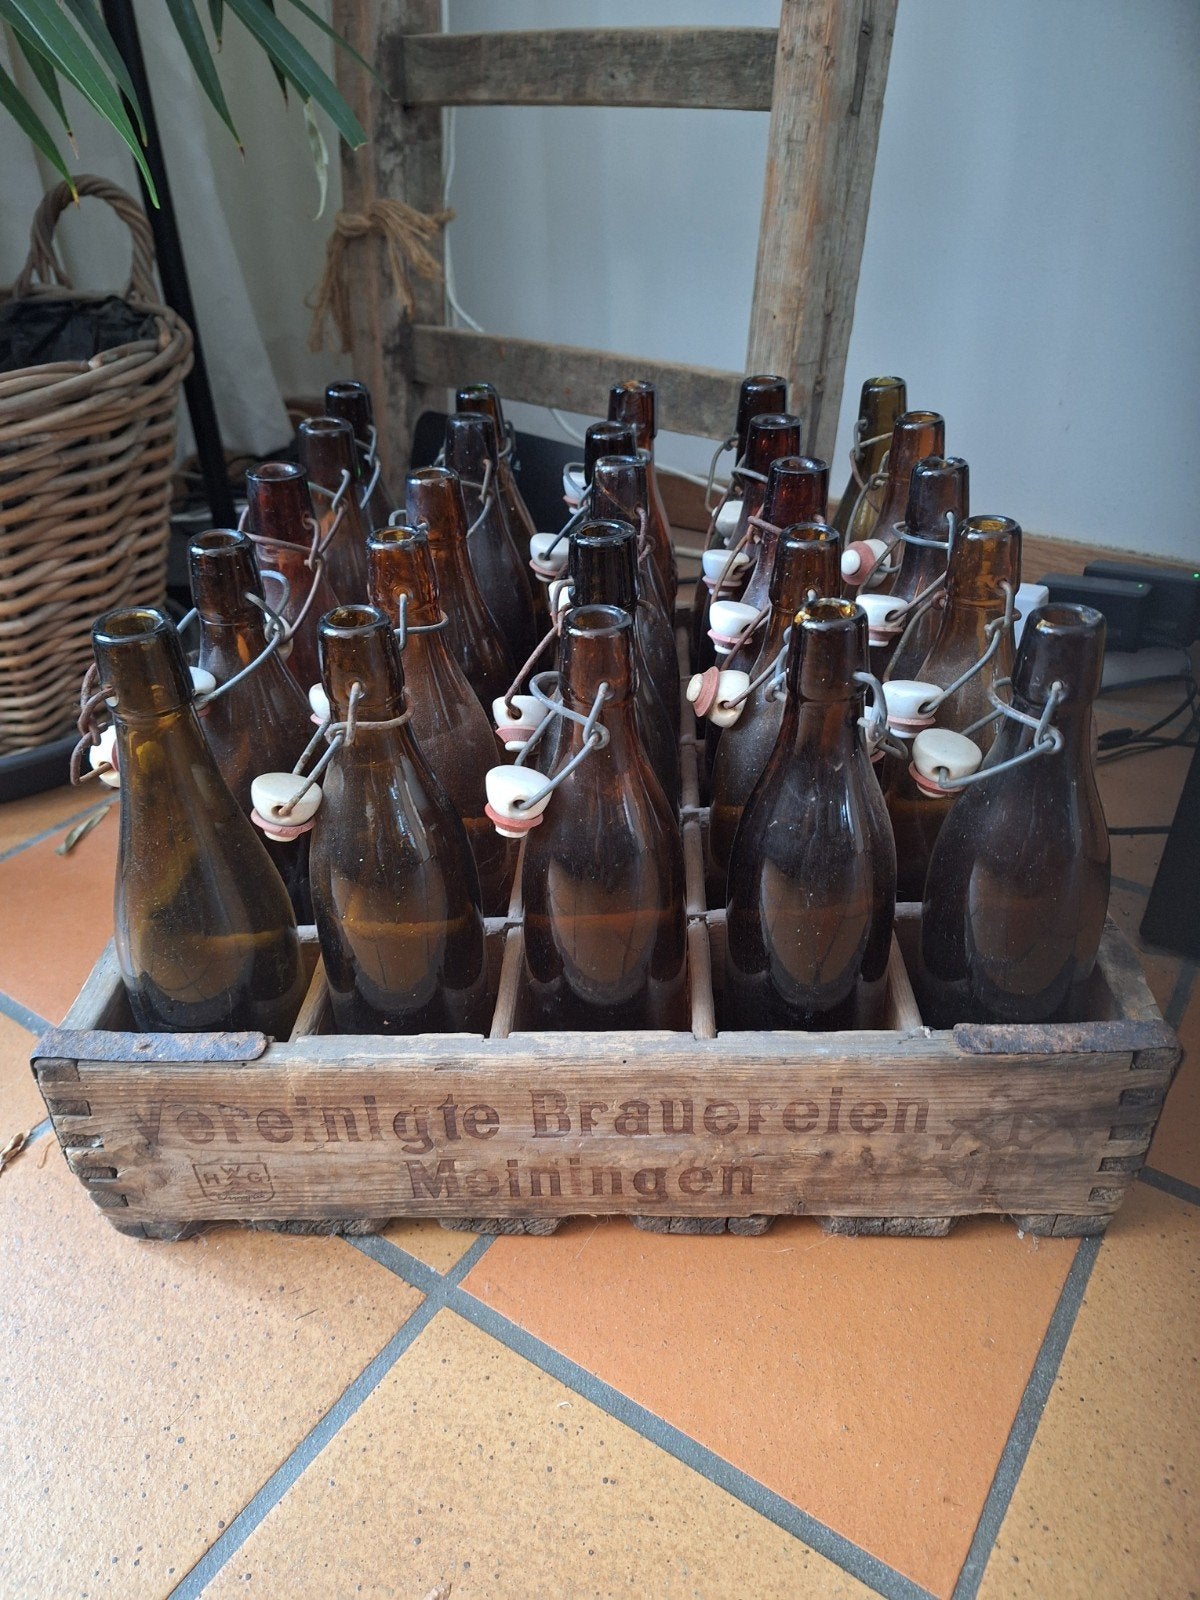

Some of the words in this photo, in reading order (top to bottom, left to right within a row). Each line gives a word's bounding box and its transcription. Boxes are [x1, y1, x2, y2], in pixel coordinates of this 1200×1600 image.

[135, 1094, 500, 1154] Vereinigte
[530, 1087, 929, 1138] Brauereien
[404, 1158, 754, 1203] Meiningen
